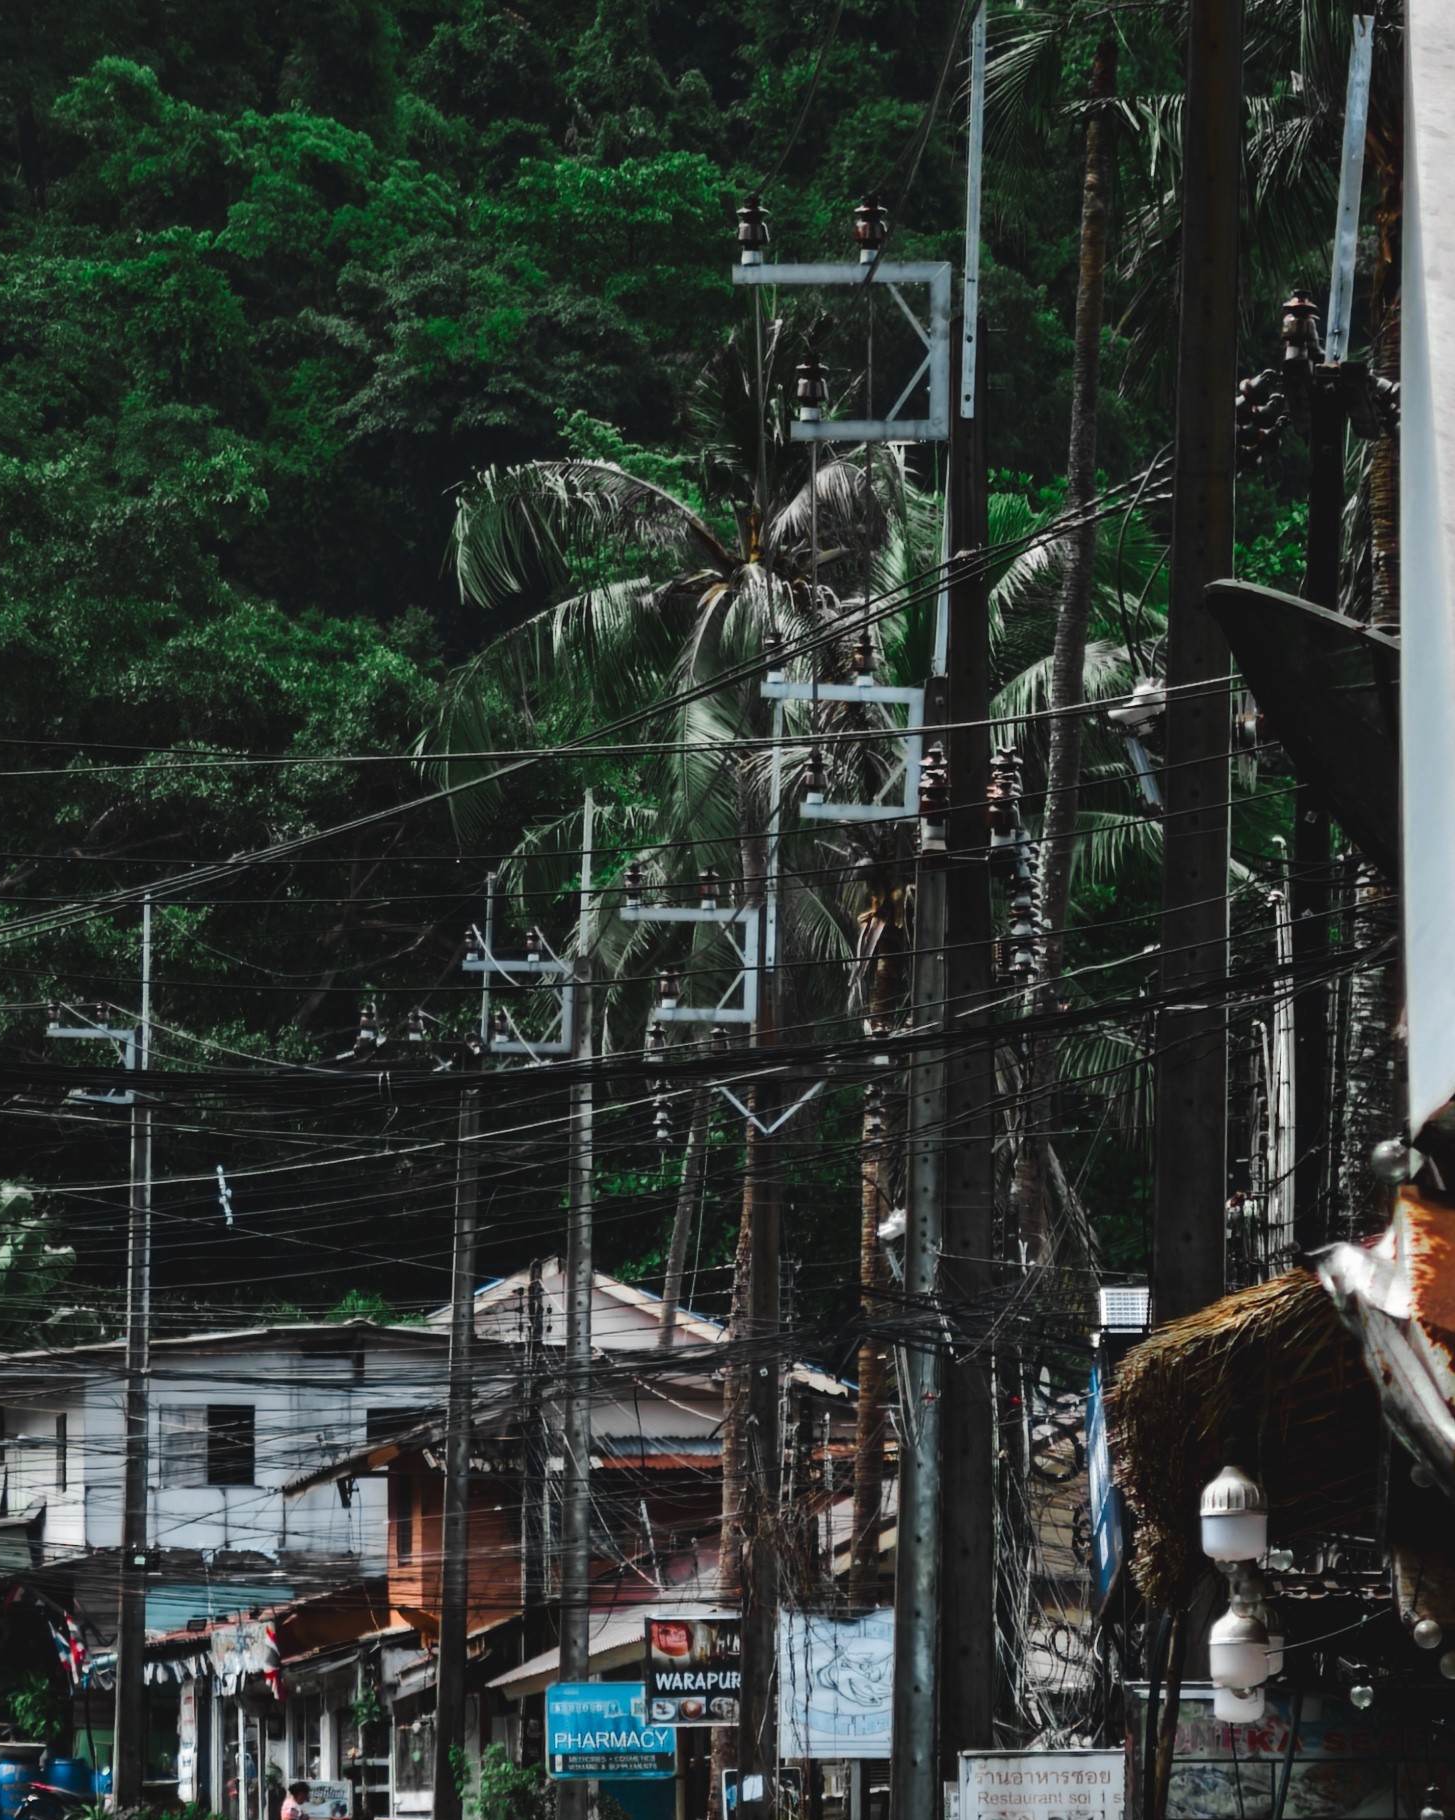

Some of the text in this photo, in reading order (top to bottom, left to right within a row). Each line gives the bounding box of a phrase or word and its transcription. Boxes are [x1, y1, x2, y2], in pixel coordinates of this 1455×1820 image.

[554, 1730, 668, 1749] PHARMACY
[975, 1761, 1112, 1785] ร้านอาหารซอย
[977, 1791, 1063, 1805] Restaurant
[1068, 1790, 1091, 1805] soi
